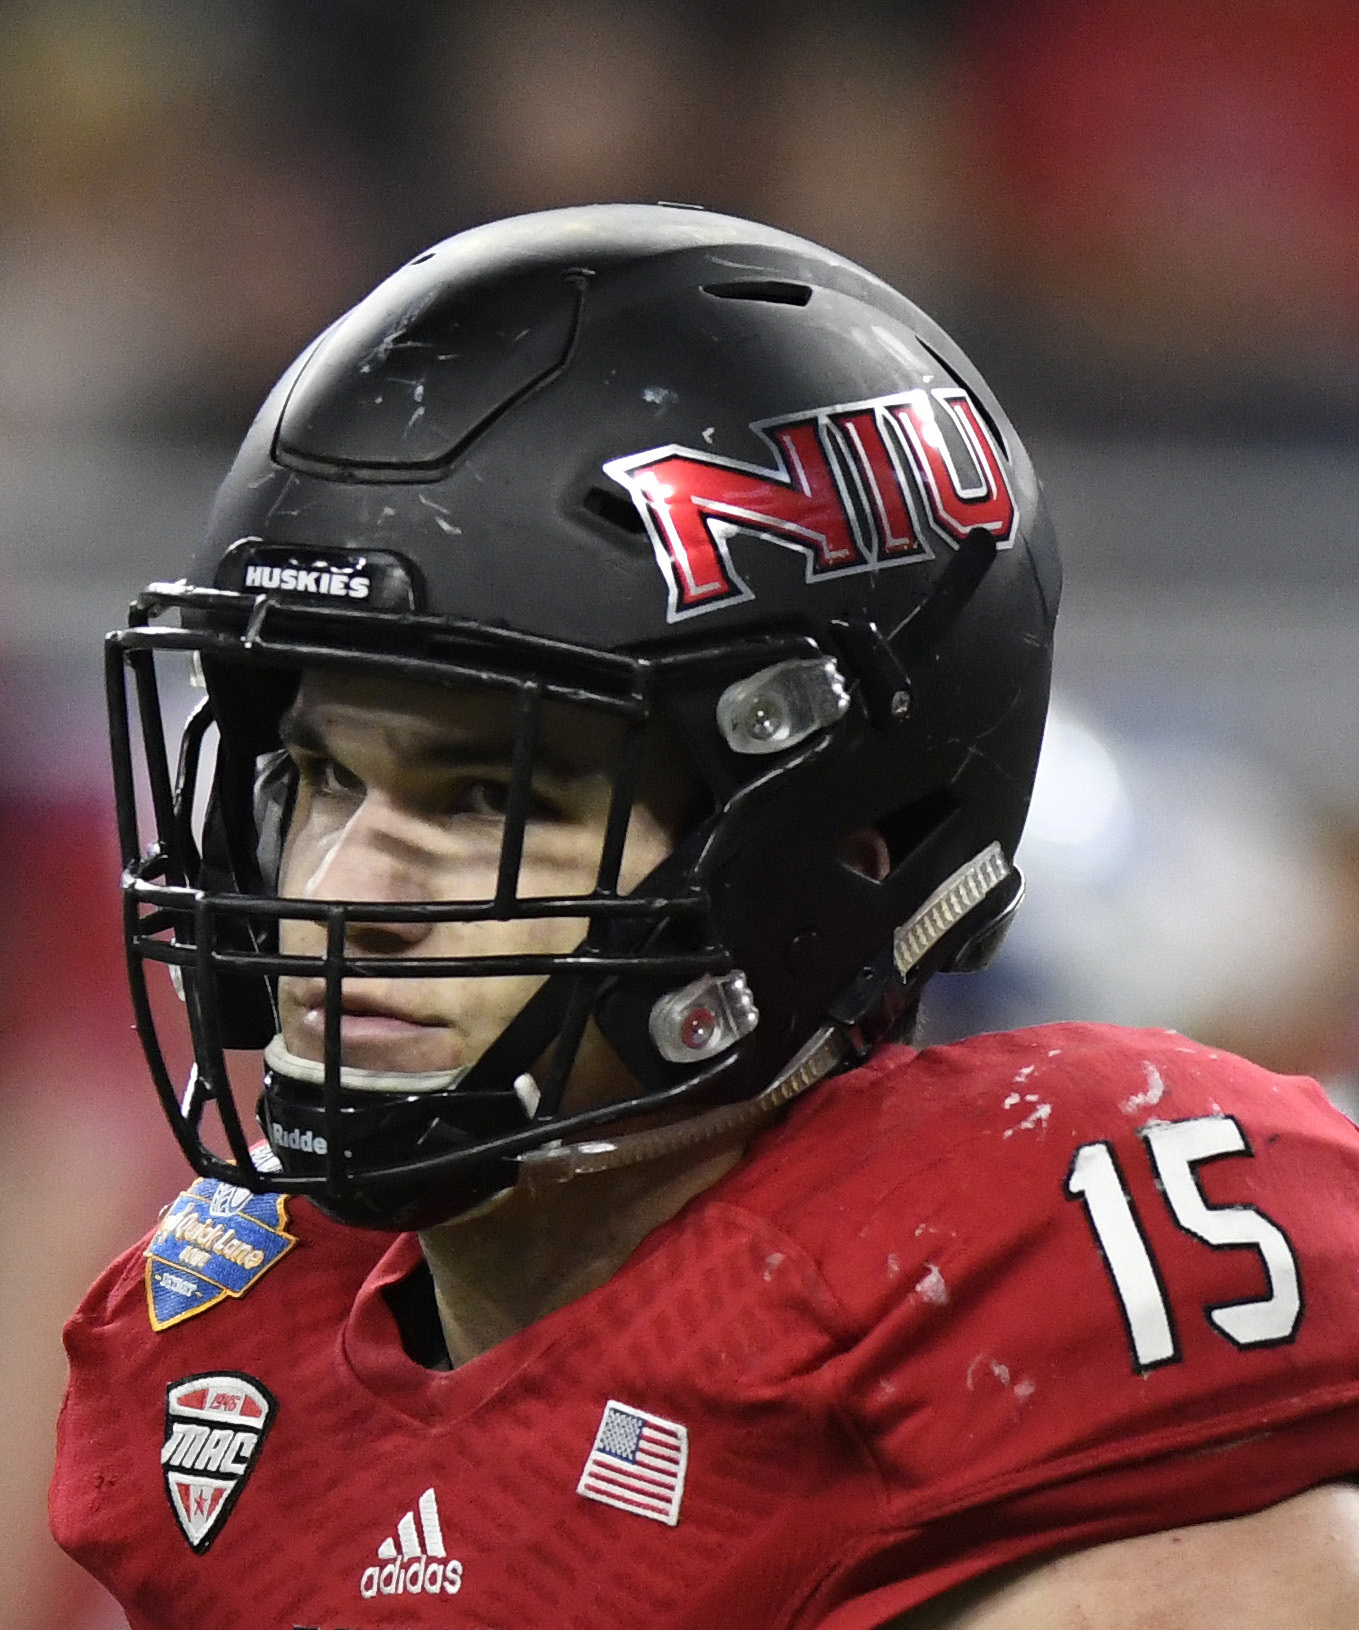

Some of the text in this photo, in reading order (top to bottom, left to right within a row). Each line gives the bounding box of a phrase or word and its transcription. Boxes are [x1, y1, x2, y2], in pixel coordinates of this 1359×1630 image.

[603, 387, 1020, 624] NIU
[245, 565, 370, 599] HUSKIES
[272, 1122, 353, 1158] Ridde
[1064, 1114, 1306, 1374] 15
[161, 1423, 258, 1475] MAC
[361, 1554, 463, 1599] adidas
